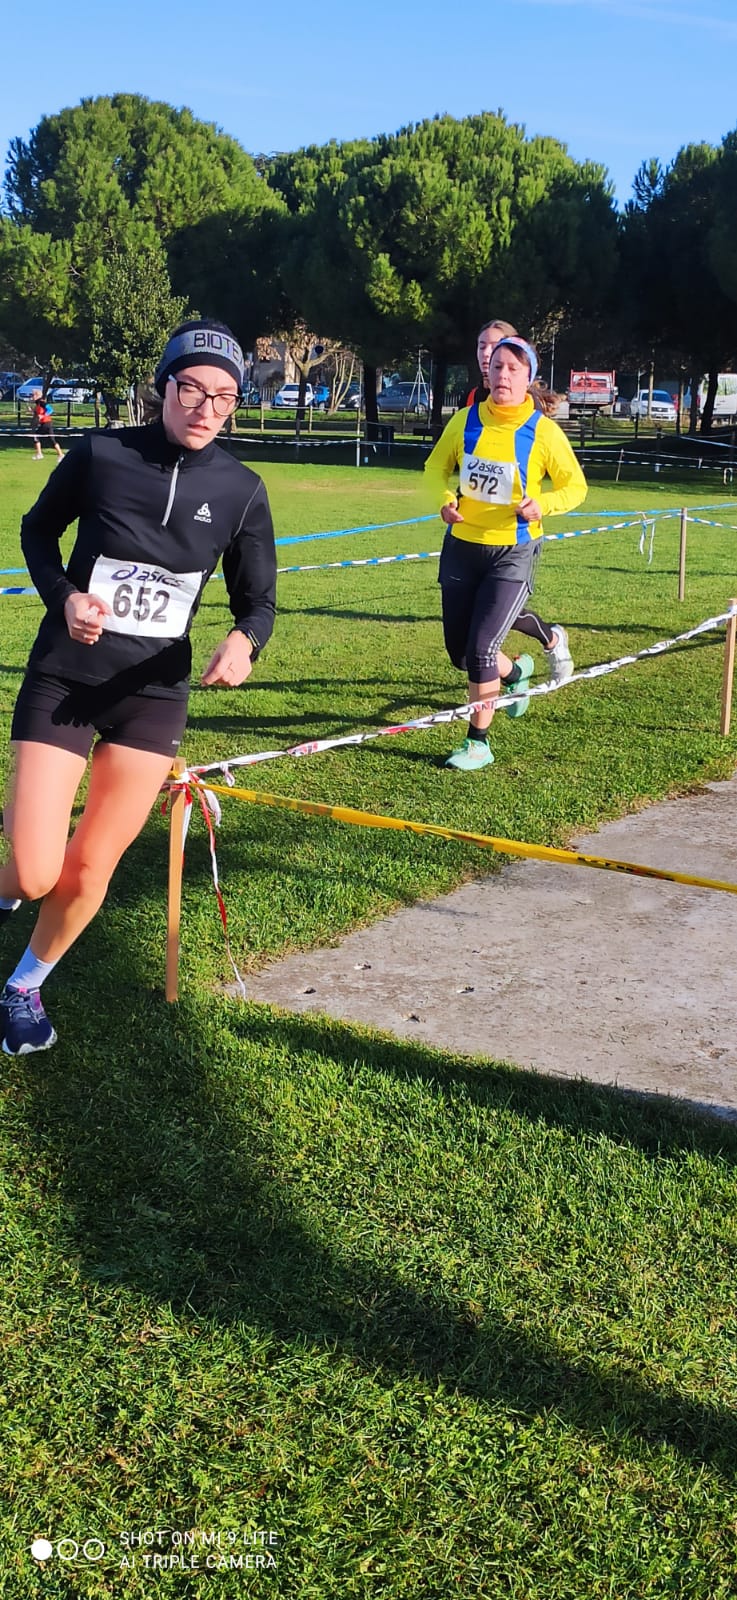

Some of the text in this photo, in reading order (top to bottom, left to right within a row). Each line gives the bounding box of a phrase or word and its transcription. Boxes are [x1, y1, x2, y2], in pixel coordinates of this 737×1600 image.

[478, 462, 504, 475] asics
[468, 472, 498, 495] 572
[136, 571, 184, 588] asics
[113, 584, 170, 623] 652
